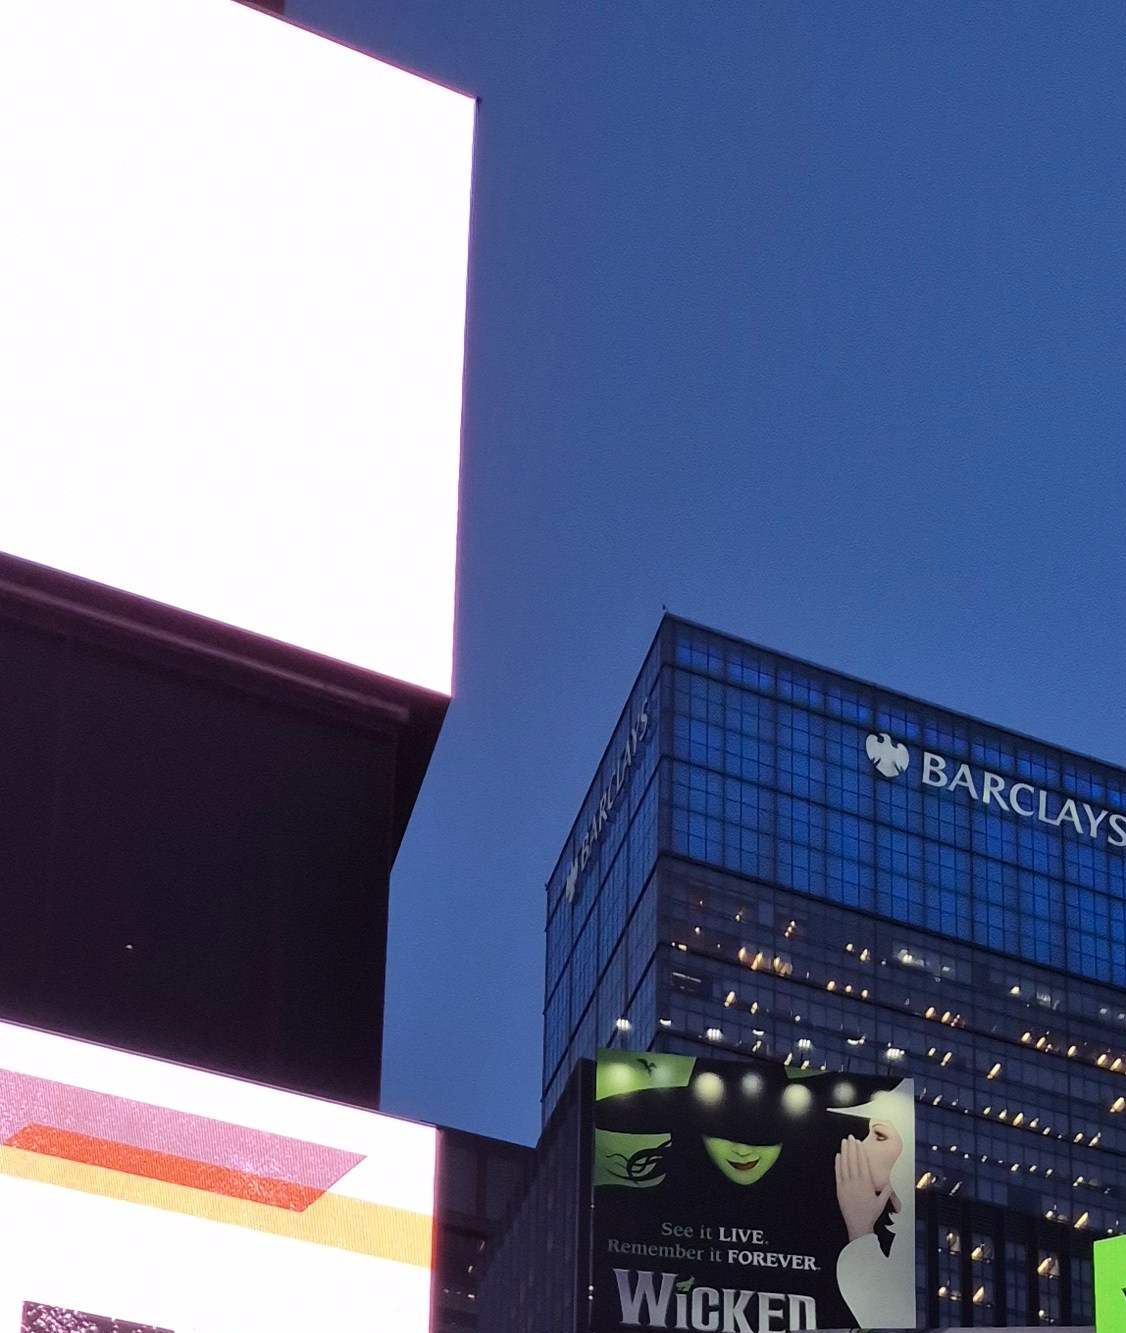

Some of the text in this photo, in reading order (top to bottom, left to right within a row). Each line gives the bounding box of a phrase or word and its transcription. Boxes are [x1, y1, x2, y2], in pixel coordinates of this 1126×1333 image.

[661, 1222, 769, 1245] See it LIVE.
[608, 1238, 704, 1261] Remember
[709, 1247, 722, 1263] it
